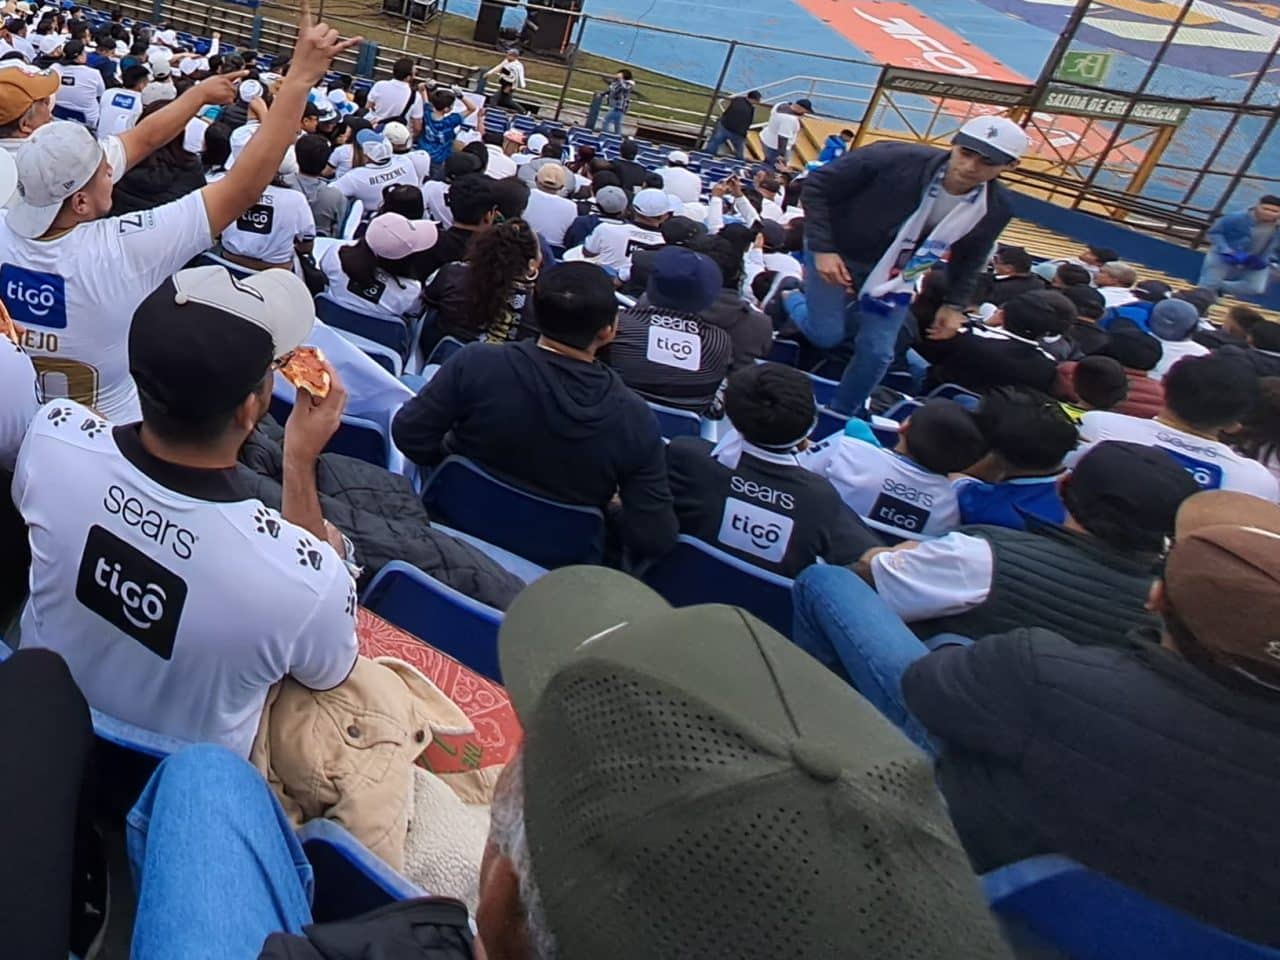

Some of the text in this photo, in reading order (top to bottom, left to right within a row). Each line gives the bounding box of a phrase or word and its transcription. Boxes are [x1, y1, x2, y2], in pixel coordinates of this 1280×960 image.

[1045, 92, 1087, 110] SALIDA
[7, 280, 55, 316] tigo
[650, 314, 699, 334] sears
[656, 337, 693, 360] tigo
[730, 476, 796, 510] sears
[881, 478, 934, 508] sears
[104, 485, 197, 560] sears
[731, 513, 783, 550] tigo
[879, 507, 920, 529] tigo
[94, 557, 167, 629] tigo
